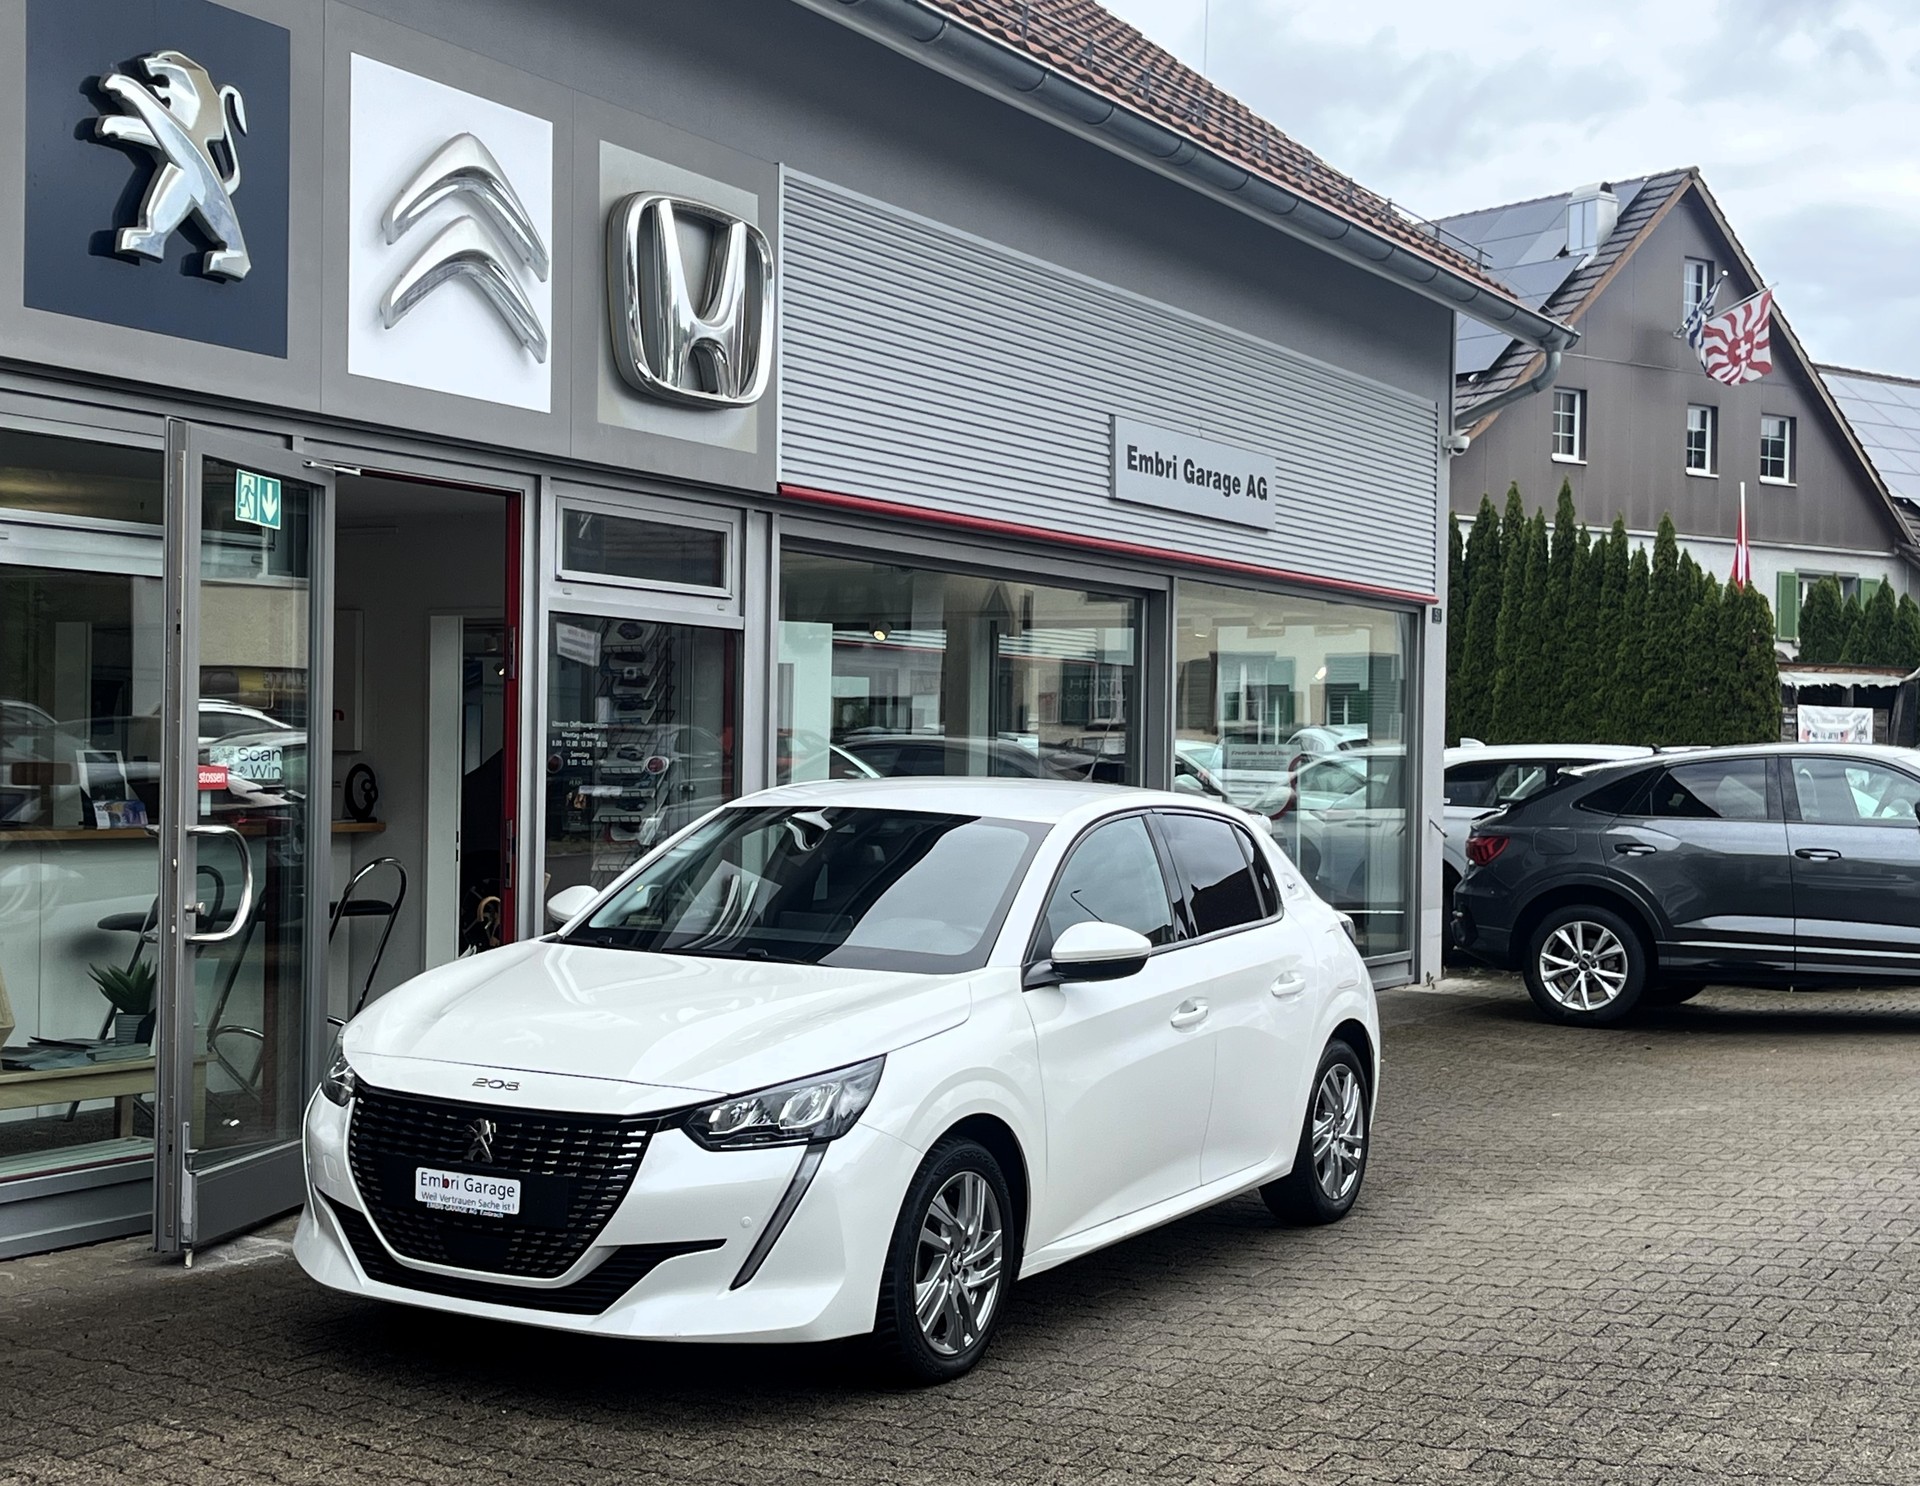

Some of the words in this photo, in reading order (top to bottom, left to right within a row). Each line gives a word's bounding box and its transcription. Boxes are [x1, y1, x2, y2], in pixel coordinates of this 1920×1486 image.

[1127, 444, 1178, 481] Embri
[1183, 458, 1241, 498] Garage
[1246, 474, 1268, 501] AG
[562, 731, 579, 740] Montag
[582, 732, 599, 741] Freitag
[238, 747, 283, 762] Scan
[198, 771, 226, 784] stossen
[250, 764, 283, 779] Win
[472, 1078, 521, 1091] 208
[420, 1171, 459, 1190] Embri
[464, 1177, 515, 1200] Garage
[421, 1191, 438, 1200] Weil
[440, 1194, 477, 1206] Vertrauen
[478, 1199, 500, 1211] Sache
[502, 1203, 511, 1211] ist
